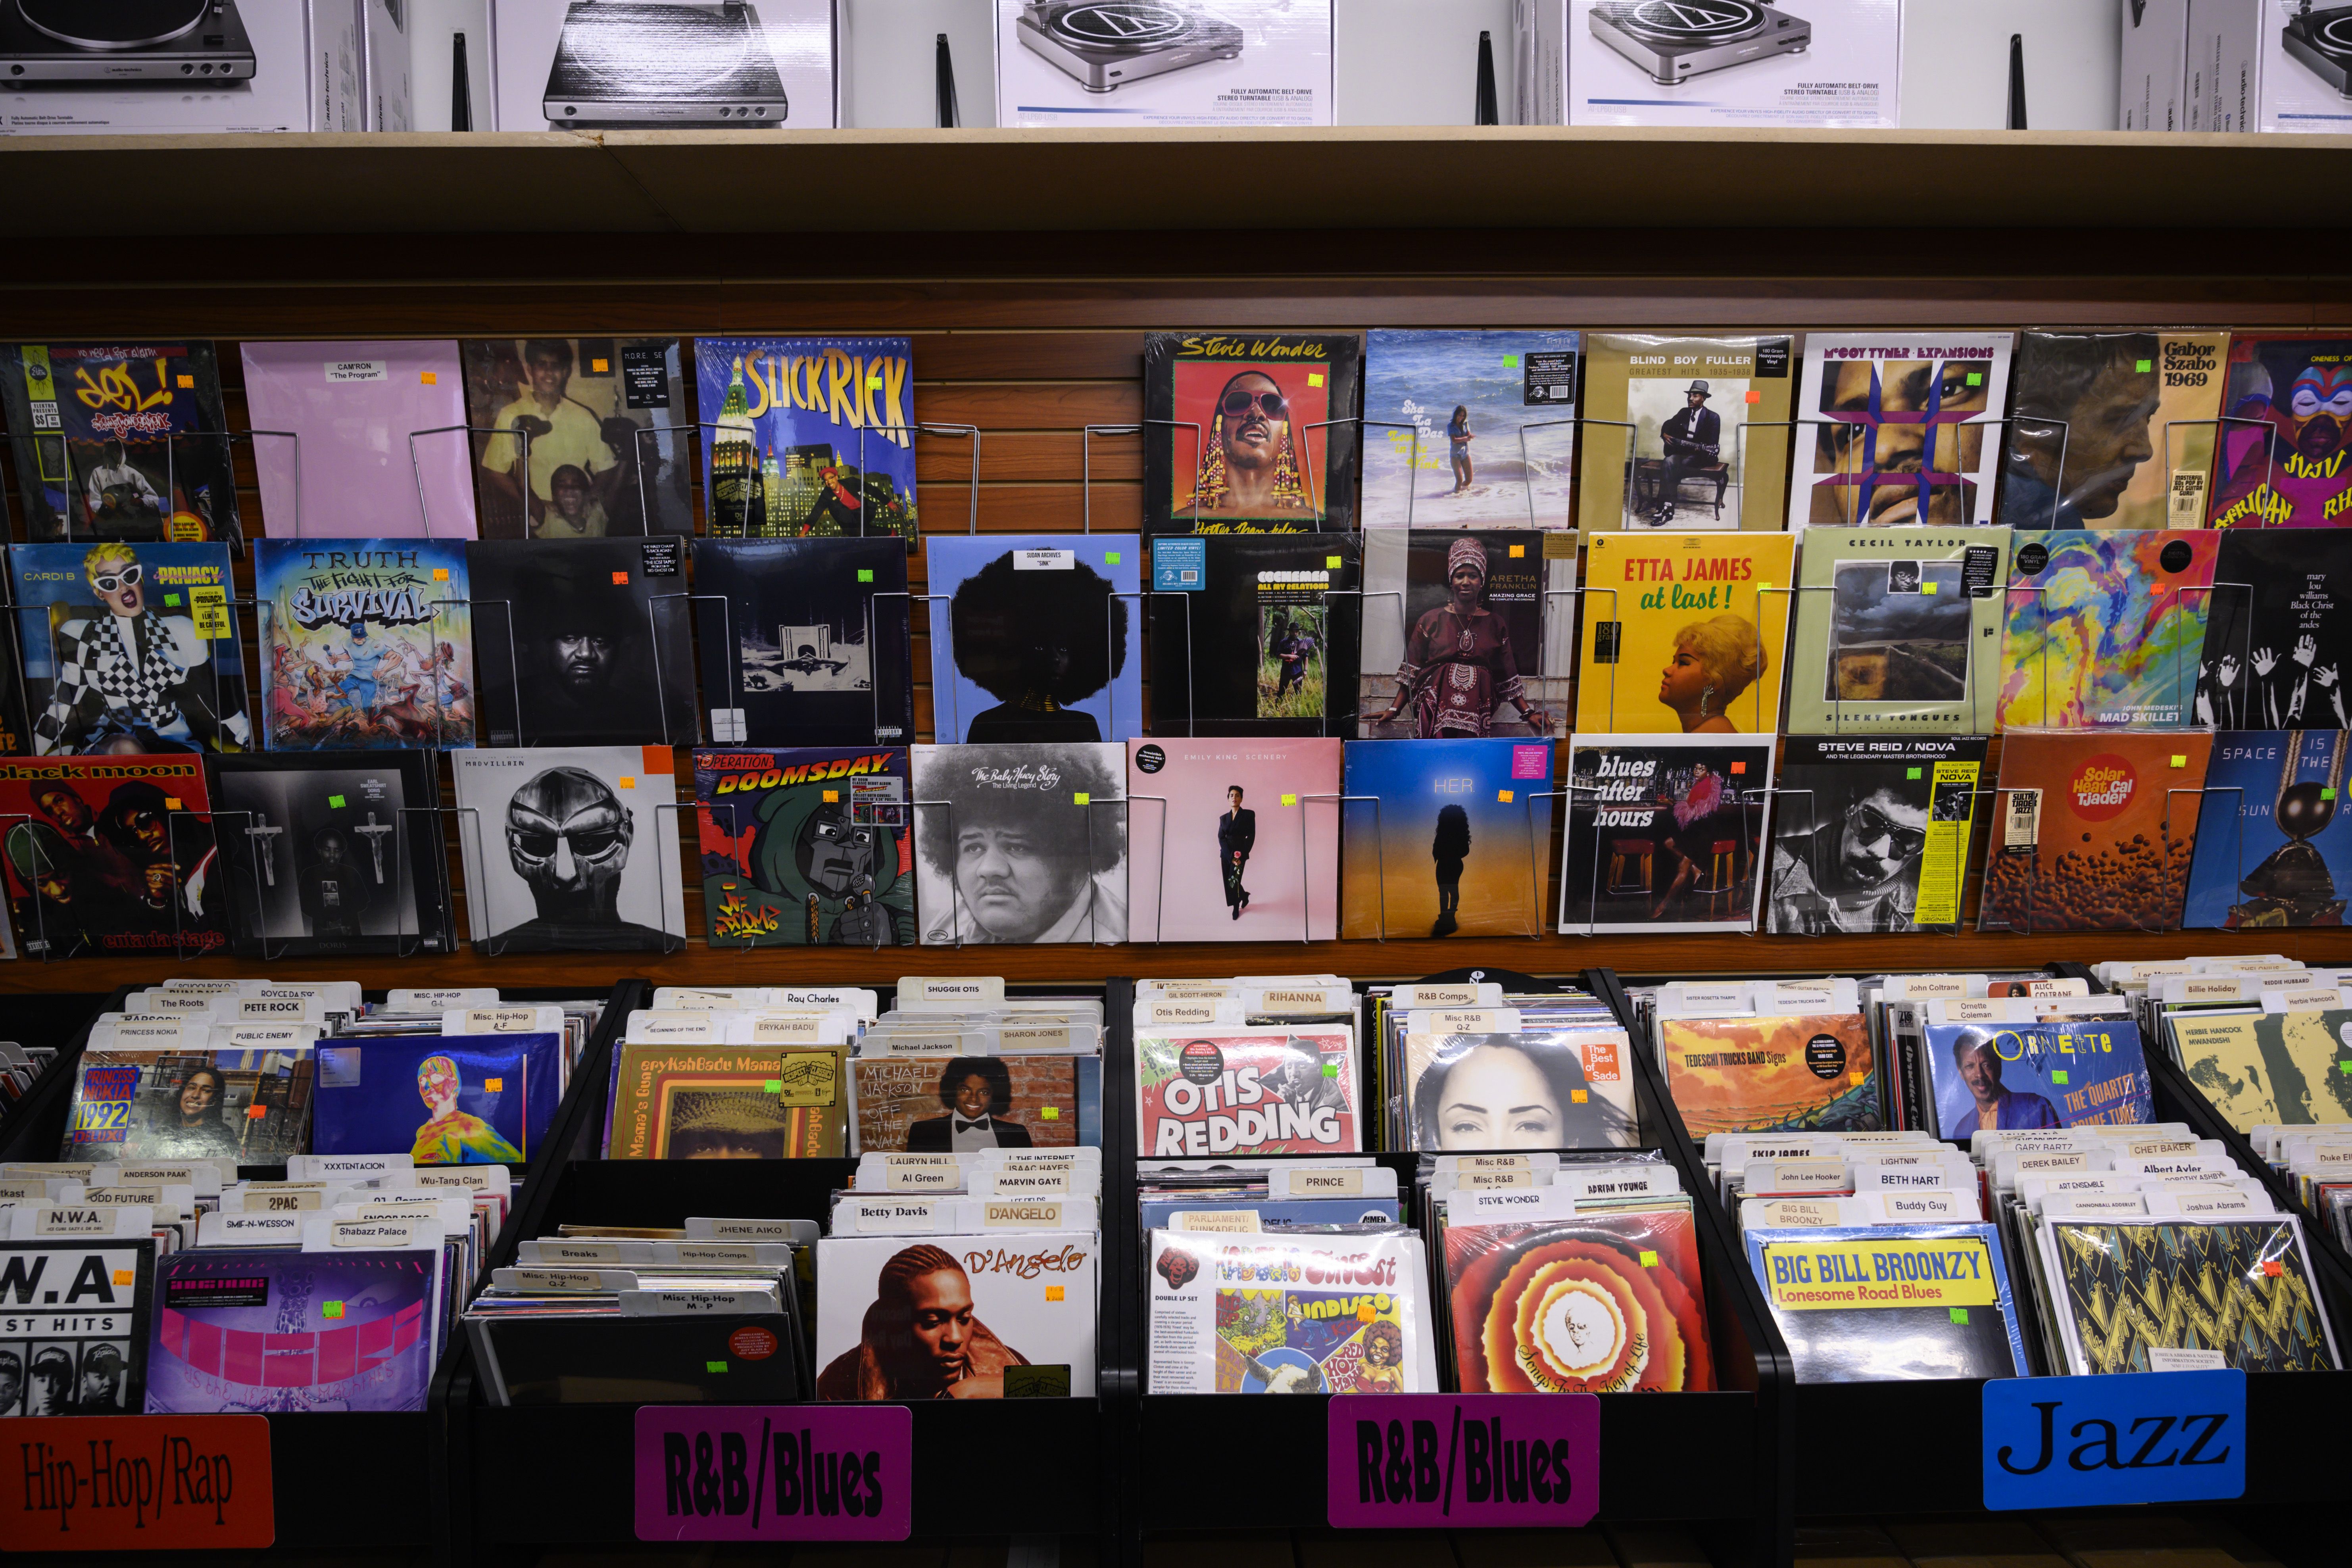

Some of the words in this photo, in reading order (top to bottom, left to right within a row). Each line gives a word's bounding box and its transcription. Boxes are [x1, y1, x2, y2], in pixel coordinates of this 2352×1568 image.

[1178, 337, 1245, 356] Stevie
[1251, 338, 1327, 357] Wonder
[1869, 348, 1909, 358] TYNER
[1917, 348, 1993, 358] EXPANSIONS
[2164, 342, 2215, 357] Gabor
[1630, 356, 1666, 365] BLIND
[1706, 356, 1751, 365] FULLER
[2164, 356, 2216, 371] Szabo
[2165, 372, 2207, 386] 1969
[1402, 400, 1424, 414] Sha
[1413, 415, 1431, 426] La
[1418, 427, 1443, 438] Das
[303, 551, 419, 569] TRUTH
[1624, 559, 1674, 581] ETTA
[1683, 558, 1752, 581] JAMES
[304, 575, 331, 591] THE
[331, 573, 388, 589] FIGHT
[386, 573, 430, 588] FOR
[1258, 571, 1329, 582] COCHEMEA
[1641, 586, 1666, 609] at
[1672, 584, 1718, 609] last
[290, 585, 440, 631] SURVIVAL
[2311, 738, 2325, 749] IS
[2223, 748, 2276, 759] SPACE
[1596, 756, 1656, 777] blues
[2302, 757, 2329, 767] THE
[90, 764, 196, 778] moon
[2084, 767, 2125, 783] Solar
[1594, 780, 1645, 801] after
[2073, 779, 2107, 793] Heat
[2111, 779, 2132, 793] Cal
[2077, 791, 2126, 806] Tjader
[1592, 805, 1654, 827] hours
[2208, 985, 2236, 993] Holiday
[788, 994, 805, 1004] Ray
[807, 994, 839, 1003] Charles
[1270, 993, 1322, 1002] RIHANNA
[1439, 992, 1470, 1001] Comps.
[269, 1003, 299, 1011] ROCK
[1175, 1008, 1209, 1017] Redding
[2189, 1037, 2230, 1045] MWANDISHI
[1588, 1045, 1606, 1053] The
[1591, 1054, 1613, 1063] Best
[1585, 1063, 1595, 1071] of
[1306, 1178, 1344, 1186] PRINCE
[1882, 1175, 1909, 1184] BETH
[1912, 1175, 1939, 1185] HART
[269, 1197, 297, 1210] 2PAC
[1479, 1197, 1504, 1205] STEVIE
[1506, 1195, 1539, 1204] WONDER
[1896, 1201, 1926, 1211] Buddy
[1929, 1201, 1947, 1211] Guy
[2186, 1203, 2214, 1212] Joshua
[2217, 1200, 2245, 1210] Abrams
[861, 1208, 892, 1218] Betty
[896, 1207, 928, 1216] Davis
[990, 1208, 1056, 1220] D'ANGELO
[1772, 1255, 1812, 1284] BIG
[1817, 1254, 1870, 1283] BILL
[1872, 1251, 1981, 1282] BROONZY
[1778, 1288, 1854, 1302] Lonesome
[1859, 1284, 1899, 1300] Road
[1902, 1284, 1942, 1299] Blues
[1996, 1400, 2231, 1477] Jazz
[1357, 1404, 1571, 1518] R&B/Blues
[663, 1416, 883, 1530] R&B/Blues
[22, 1435, 234, 1531] Hip-Hop/Rap
